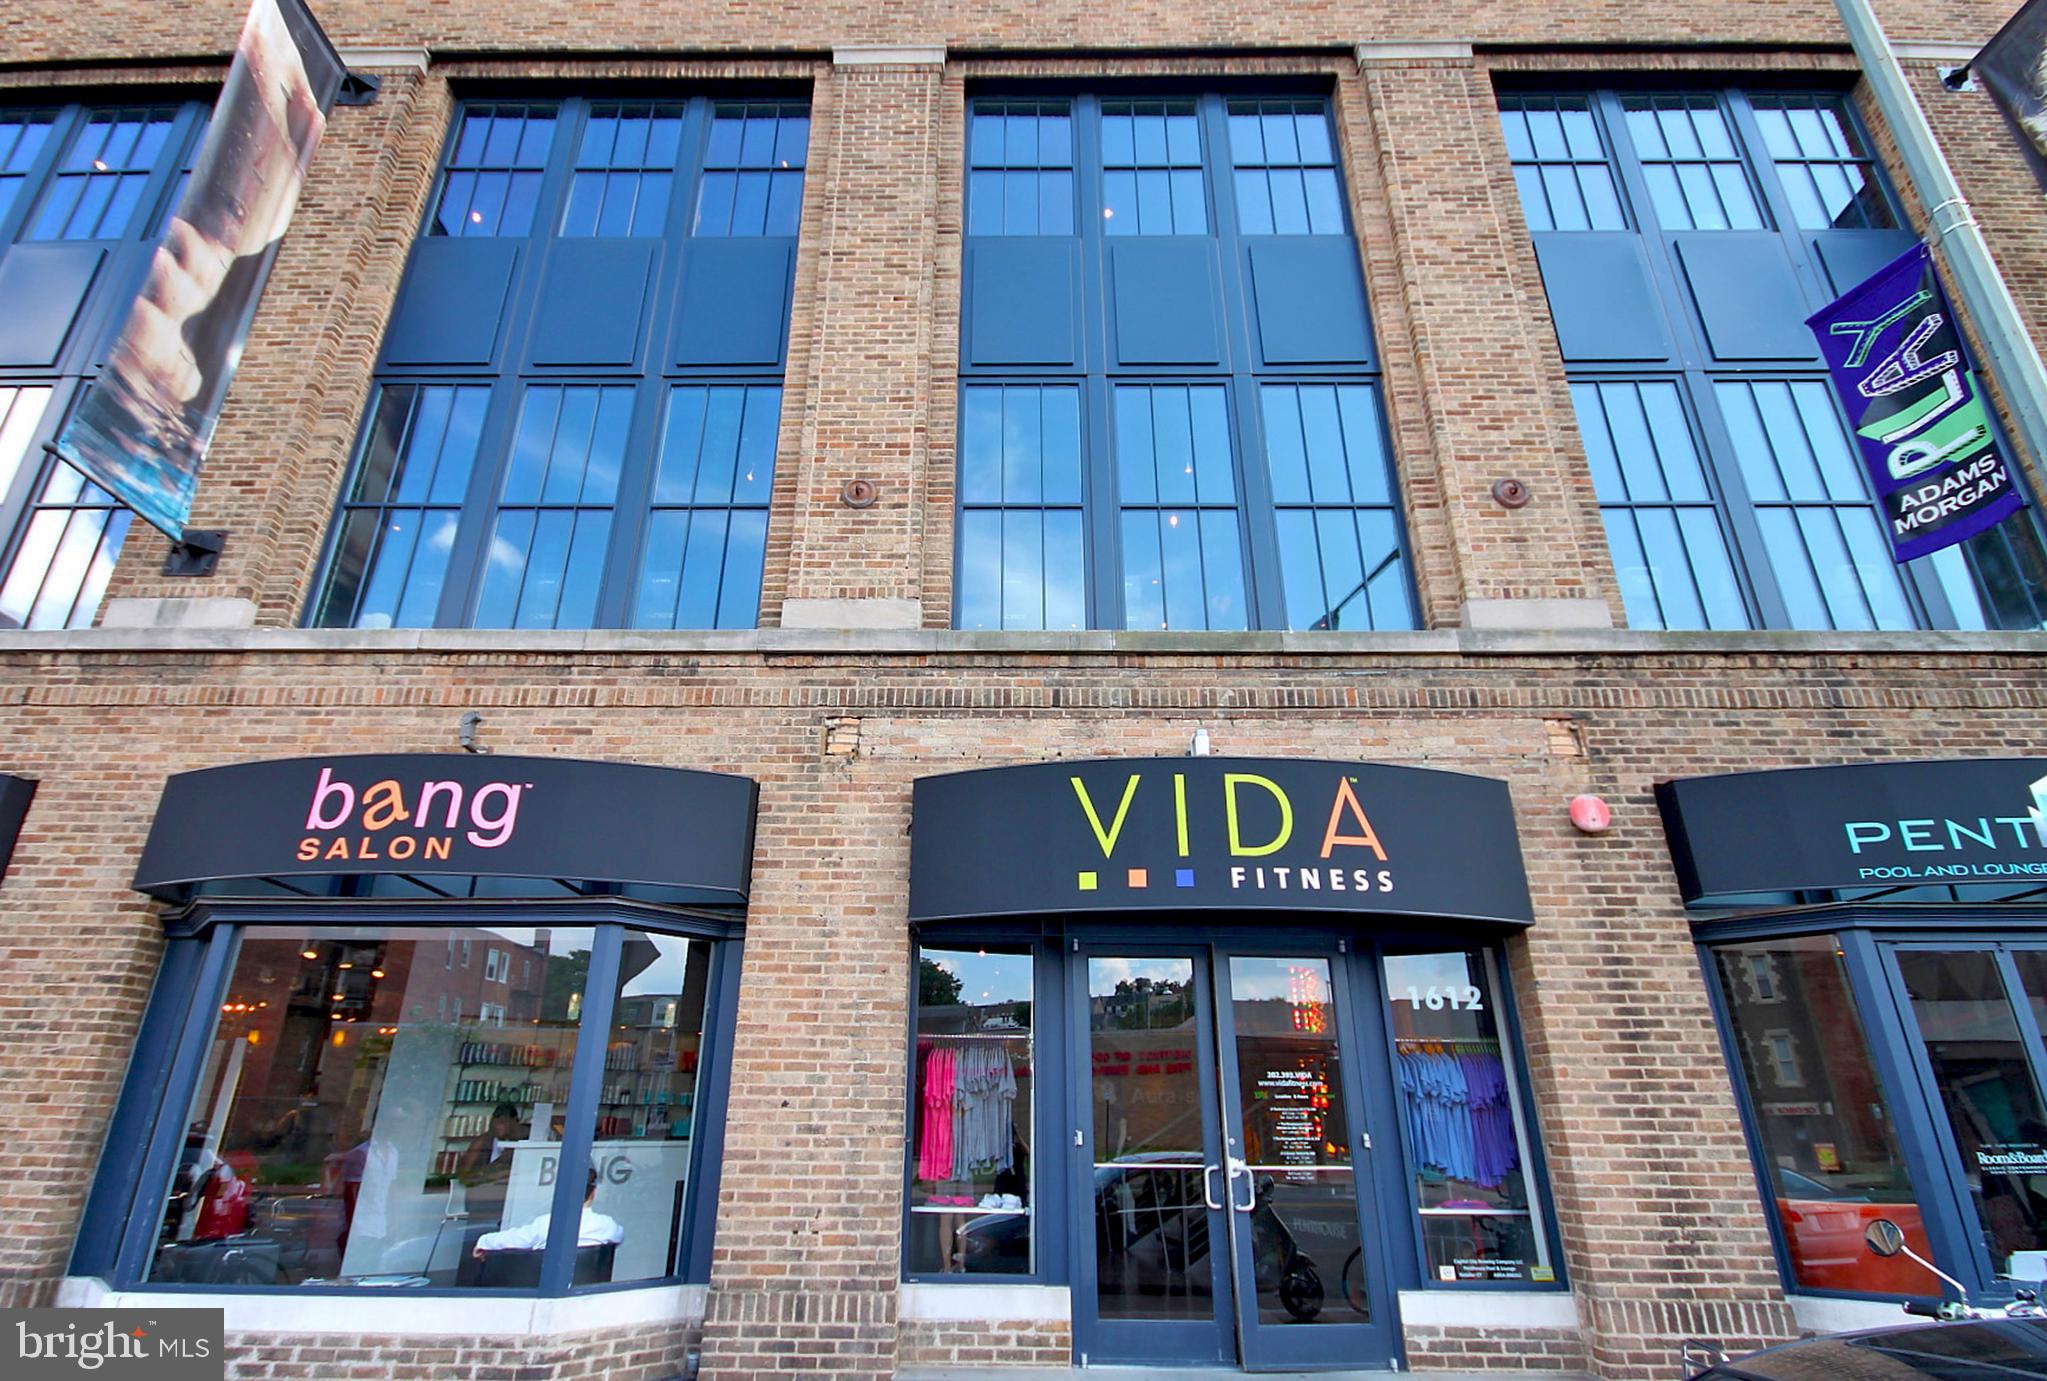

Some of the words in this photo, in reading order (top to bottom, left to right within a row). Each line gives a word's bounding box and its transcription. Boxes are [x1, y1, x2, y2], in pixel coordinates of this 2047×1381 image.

[1831, 290, 1986, 480] PLAY
[1894, 465, 2007, 535] MORGAN
[1901, 454, 1996, 513] ADAMS
[305, 768, 521, 848] bang
[1070, 773, 1389, 861] VIDA
[297, 836, 452, 861] SALON
[1230, 867, 1394, 892] FITNESS
[1859, 866, 1922, 880] POOL
[1924, 864, 1968, 877] AND
[1407, 985, 1484, 1011] 1612
[538, 1155, 634, 1187] BG
